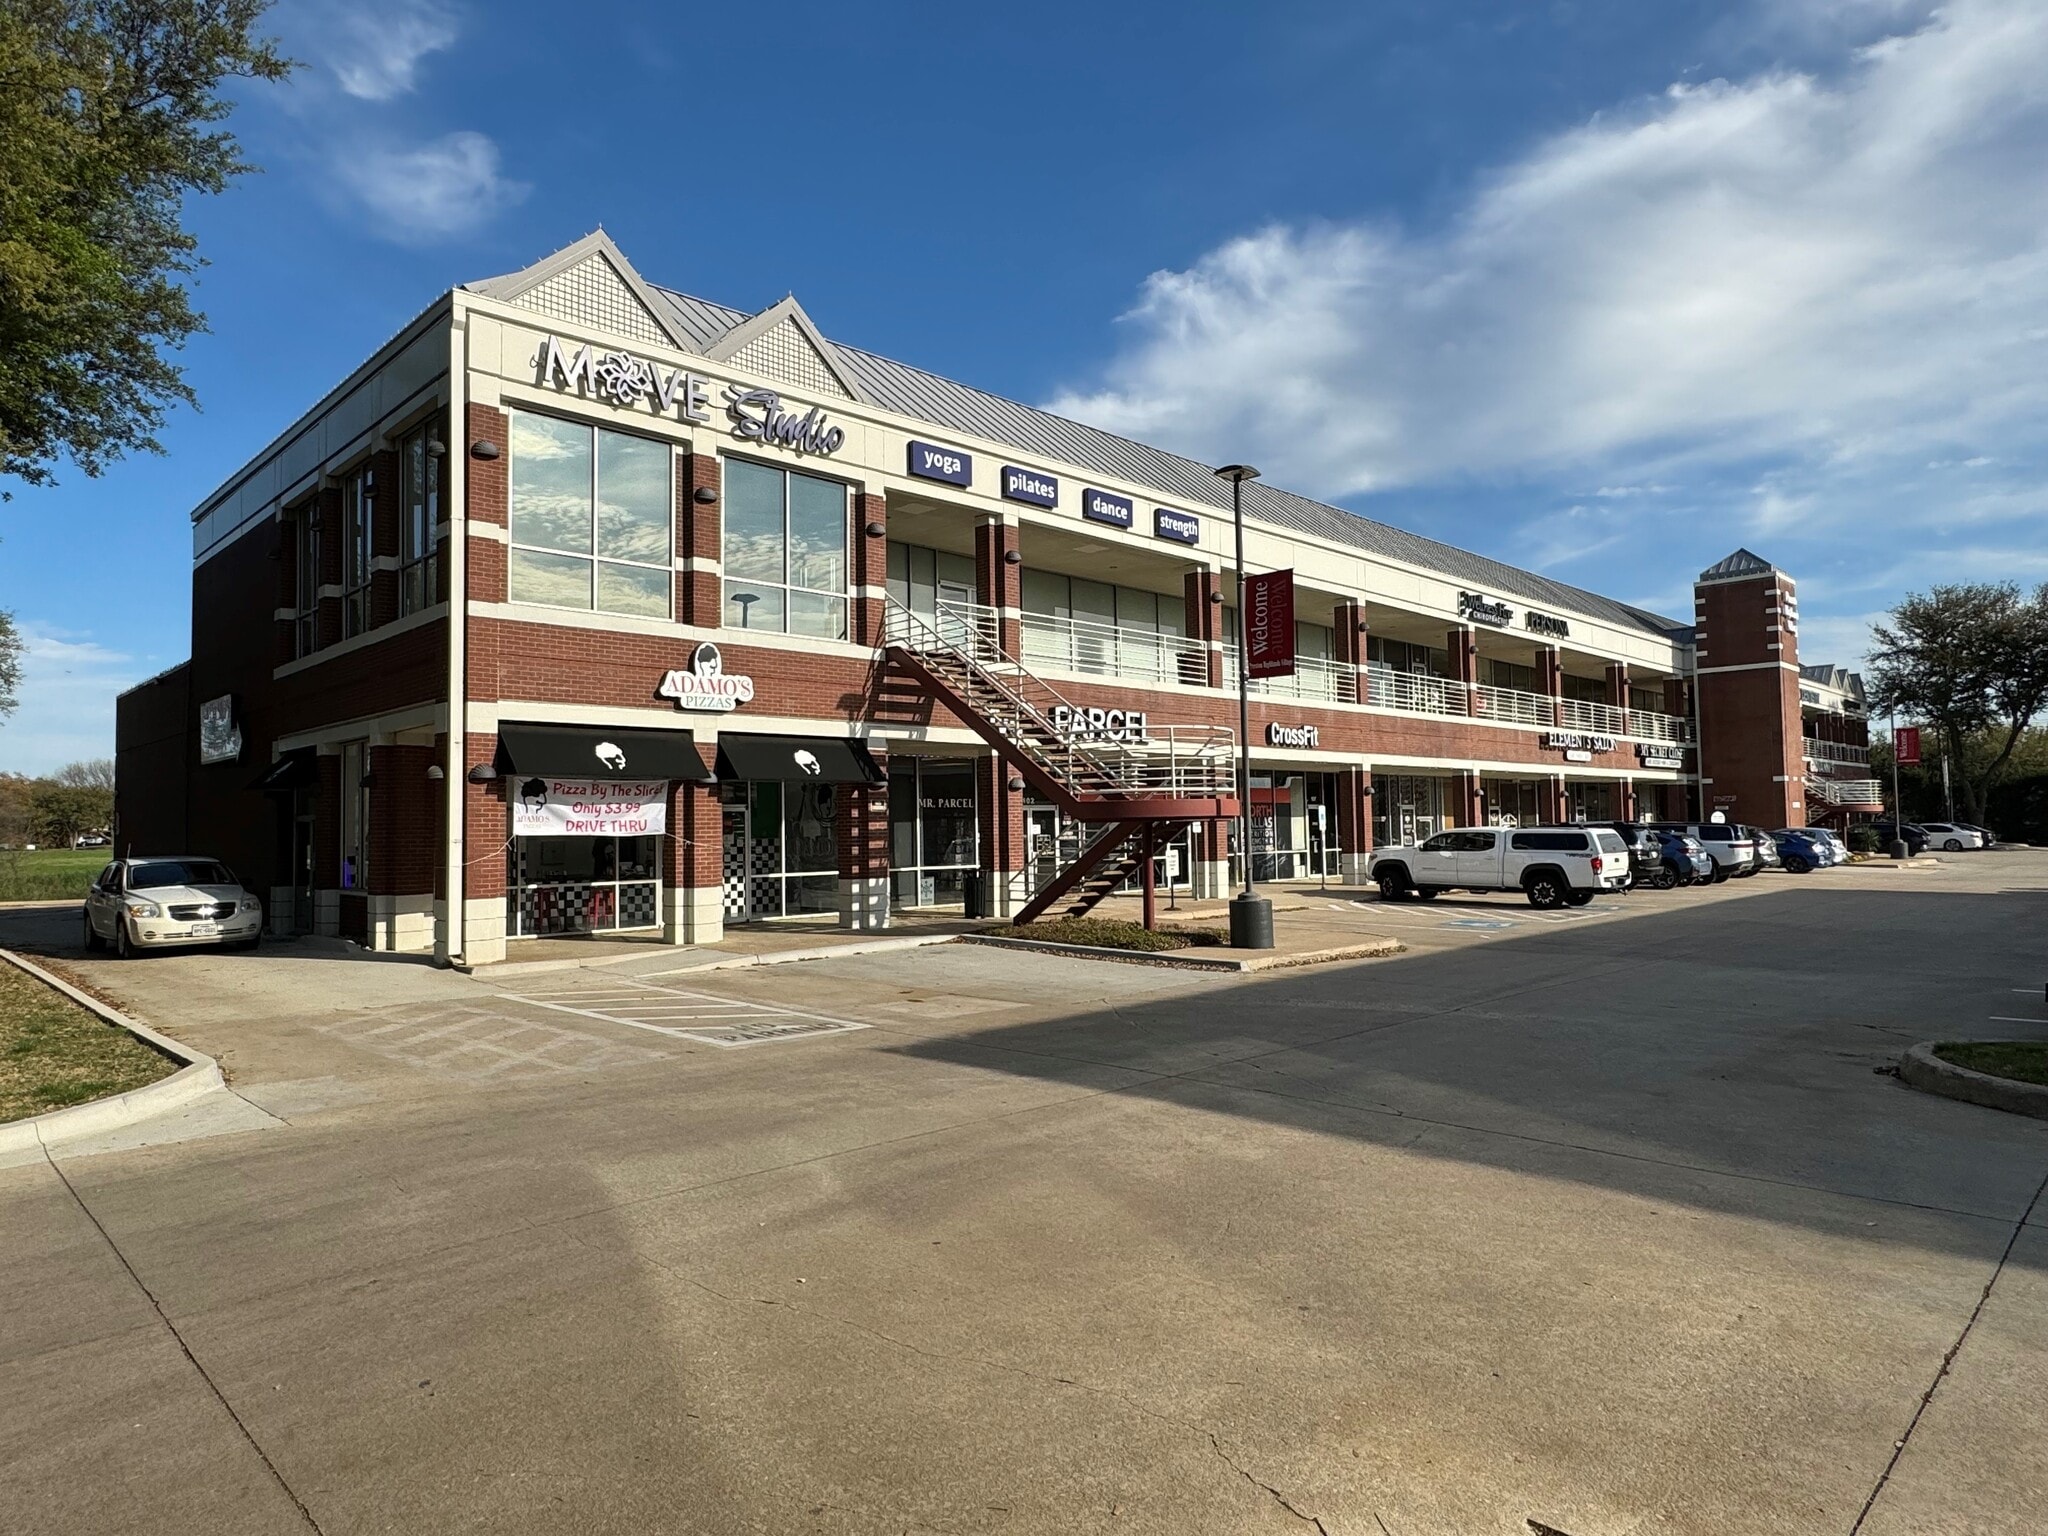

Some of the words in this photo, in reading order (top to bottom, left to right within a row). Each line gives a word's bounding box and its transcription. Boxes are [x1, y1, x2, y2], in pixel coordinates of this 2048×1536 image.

[728, 384, 846, 453] Studio
[924, 450, 961, 475] yoga
[1009, 474, 1055, 498] pilates
[1093, 497, 1128, 520] dance
[1159, 515, 1198, 538] strength
[1250, 581, 1269, 656] Welcome
[666, 675, 751, 698] ADAMO'S
[686, 695, 732, 708] PIZZAS
[1055, 705, 1148, 742] PARCEL
[1271, 721, 1319, 746] CrossFit
[553, 783, 587, 796] Pizza
[591, 784, 608, 800] By
[611, 784, 631, 797] The
[572, 801, 601, 818] Only
[918, 798, 936, 809] MR.
[938, 798, 974, 809] PARCEL
[1250, 804, 1273, 817] ORTH
[565, 820, 608, 833] DRIVE
[612, 819, 648, 833] THRU
